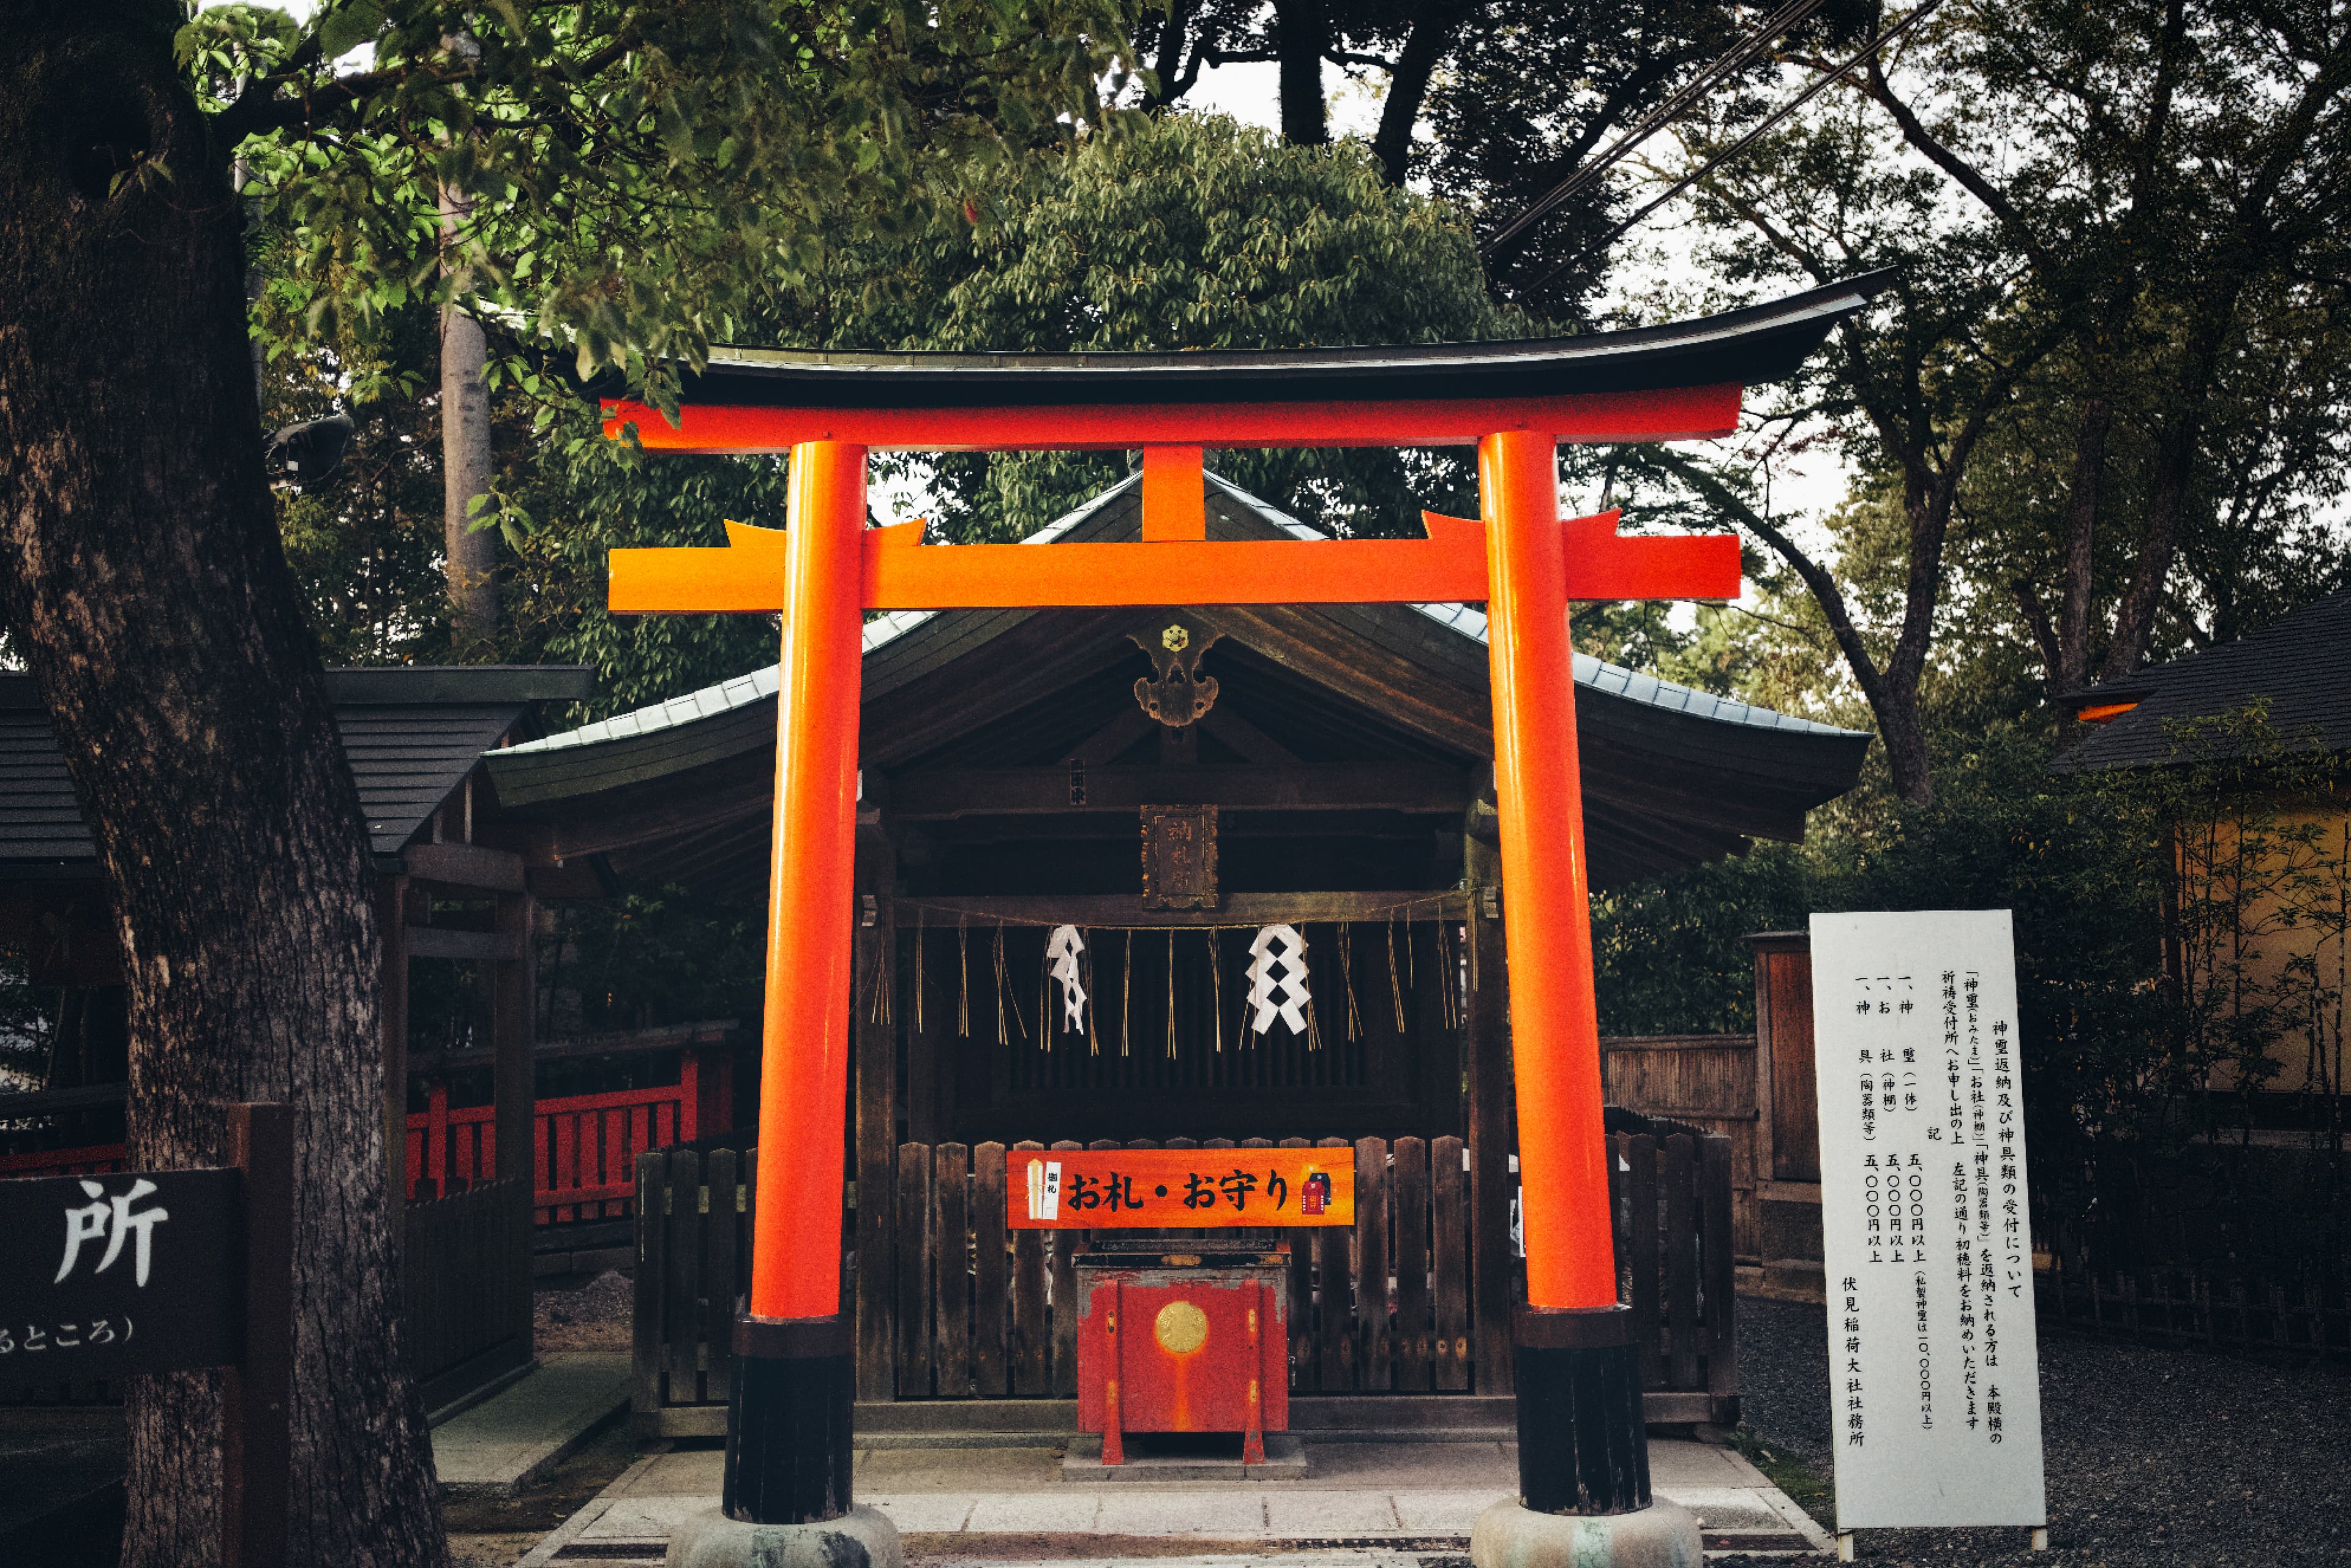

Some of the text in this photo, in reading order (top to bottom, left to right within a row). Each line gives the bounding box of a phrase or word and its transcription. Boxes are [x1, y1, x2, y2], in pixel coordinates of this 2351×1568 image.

[1927, 1127, 1942, 1141] 記
[54, 1179, 170, 1288] 所
[1842, 1277, 1864, 1447] 伏見稲荷大社社務所
[1987, 1384, 2002, 1445] 本殿横の
